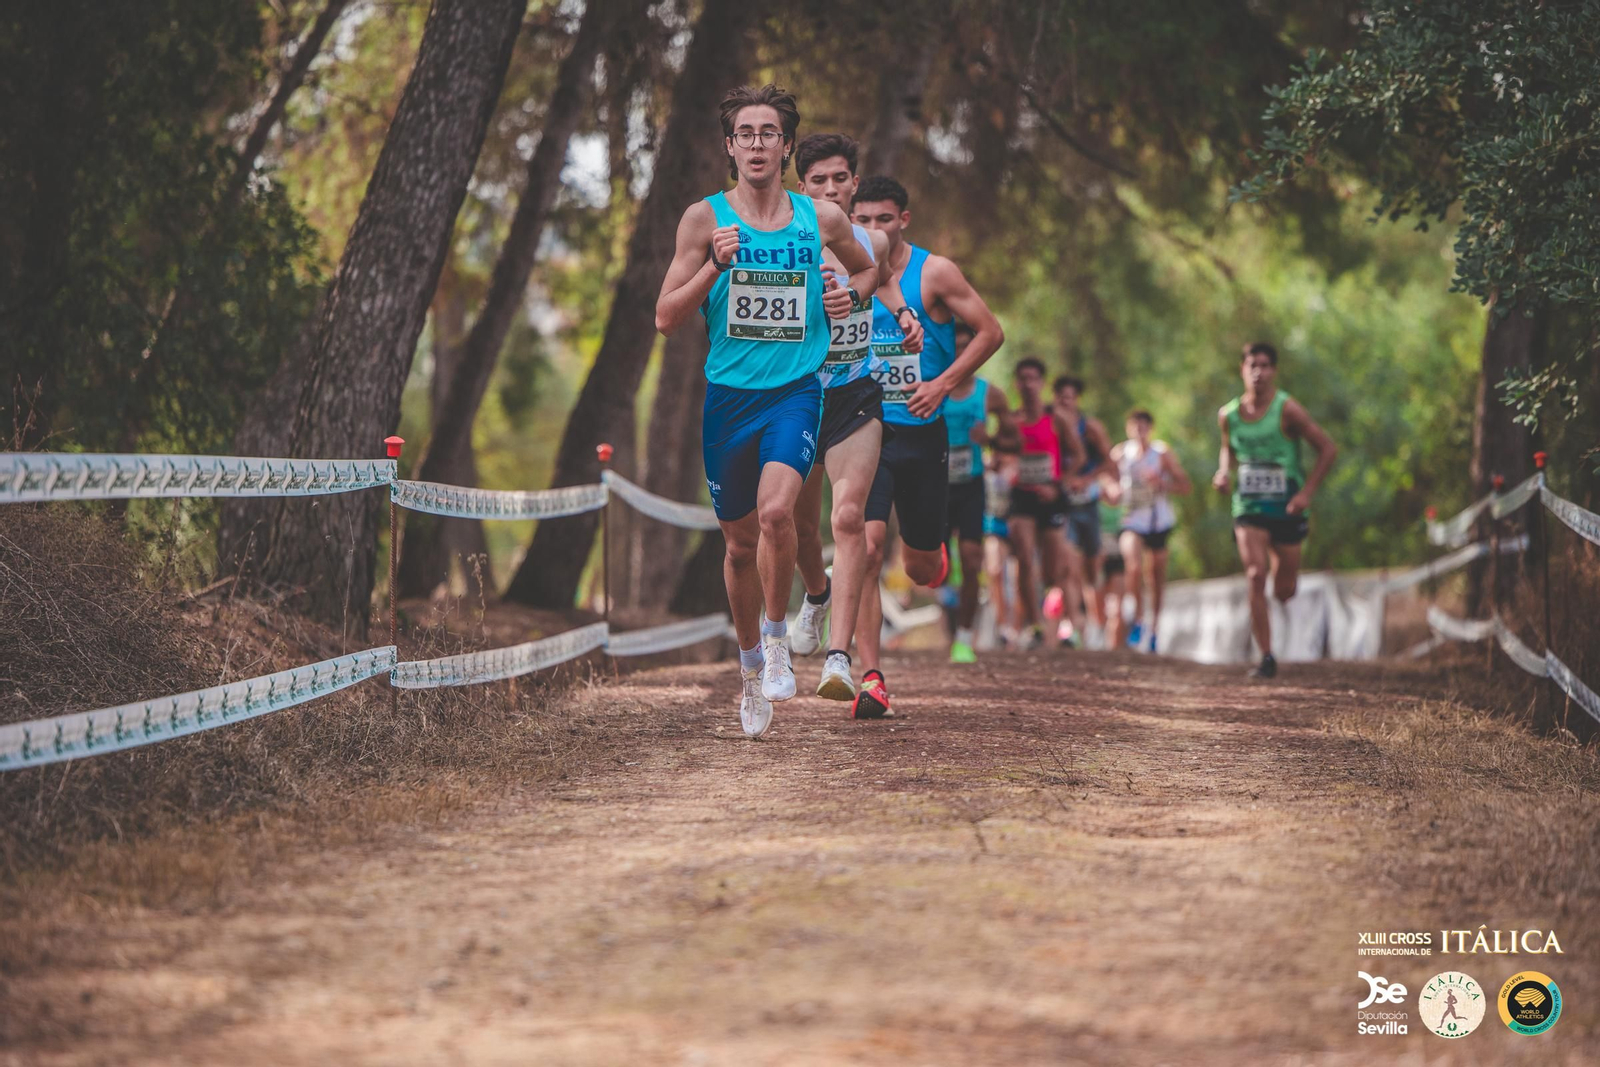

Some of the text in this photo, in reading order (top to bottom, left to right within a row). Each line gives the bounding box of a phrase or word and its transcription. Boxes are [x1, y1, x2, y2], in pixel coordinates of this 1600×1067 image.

[736, 241, 813, 270] nerja
[753, 272, 788, 282] ITÁLICA
[735, 296, 800, 321] 8281
[831, 321, 869, 346] 239
